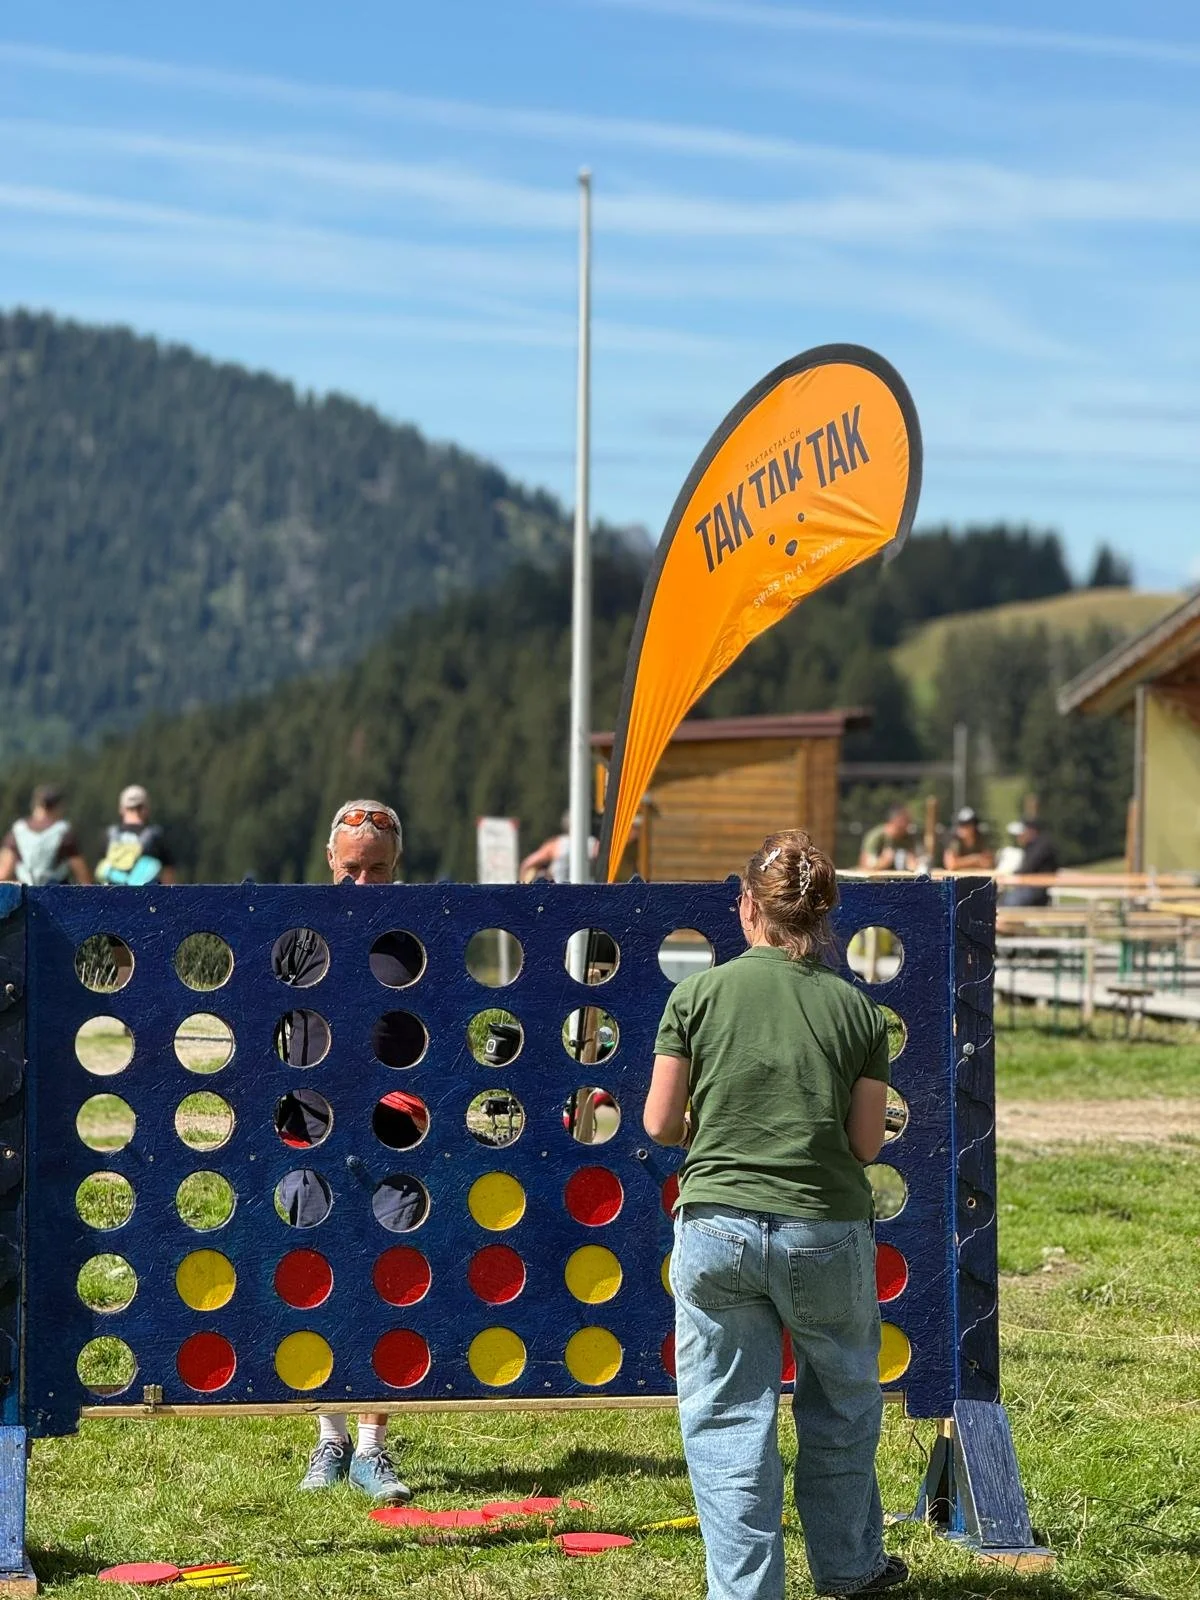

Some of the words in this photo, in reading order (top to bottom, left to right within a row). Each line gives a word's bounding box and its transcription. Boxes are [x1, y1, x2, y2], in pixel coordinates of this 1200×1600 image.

[745, 428, 801, 471] TAKTAKTAK.CH
[695, 482, 754, 573] TAK
[748, 441, 803, 509] TAK
[805, 404, 870, 488] TAK
[753, 580, 780, 609] SWISS
[784, 560, 808, 585] PLAY
